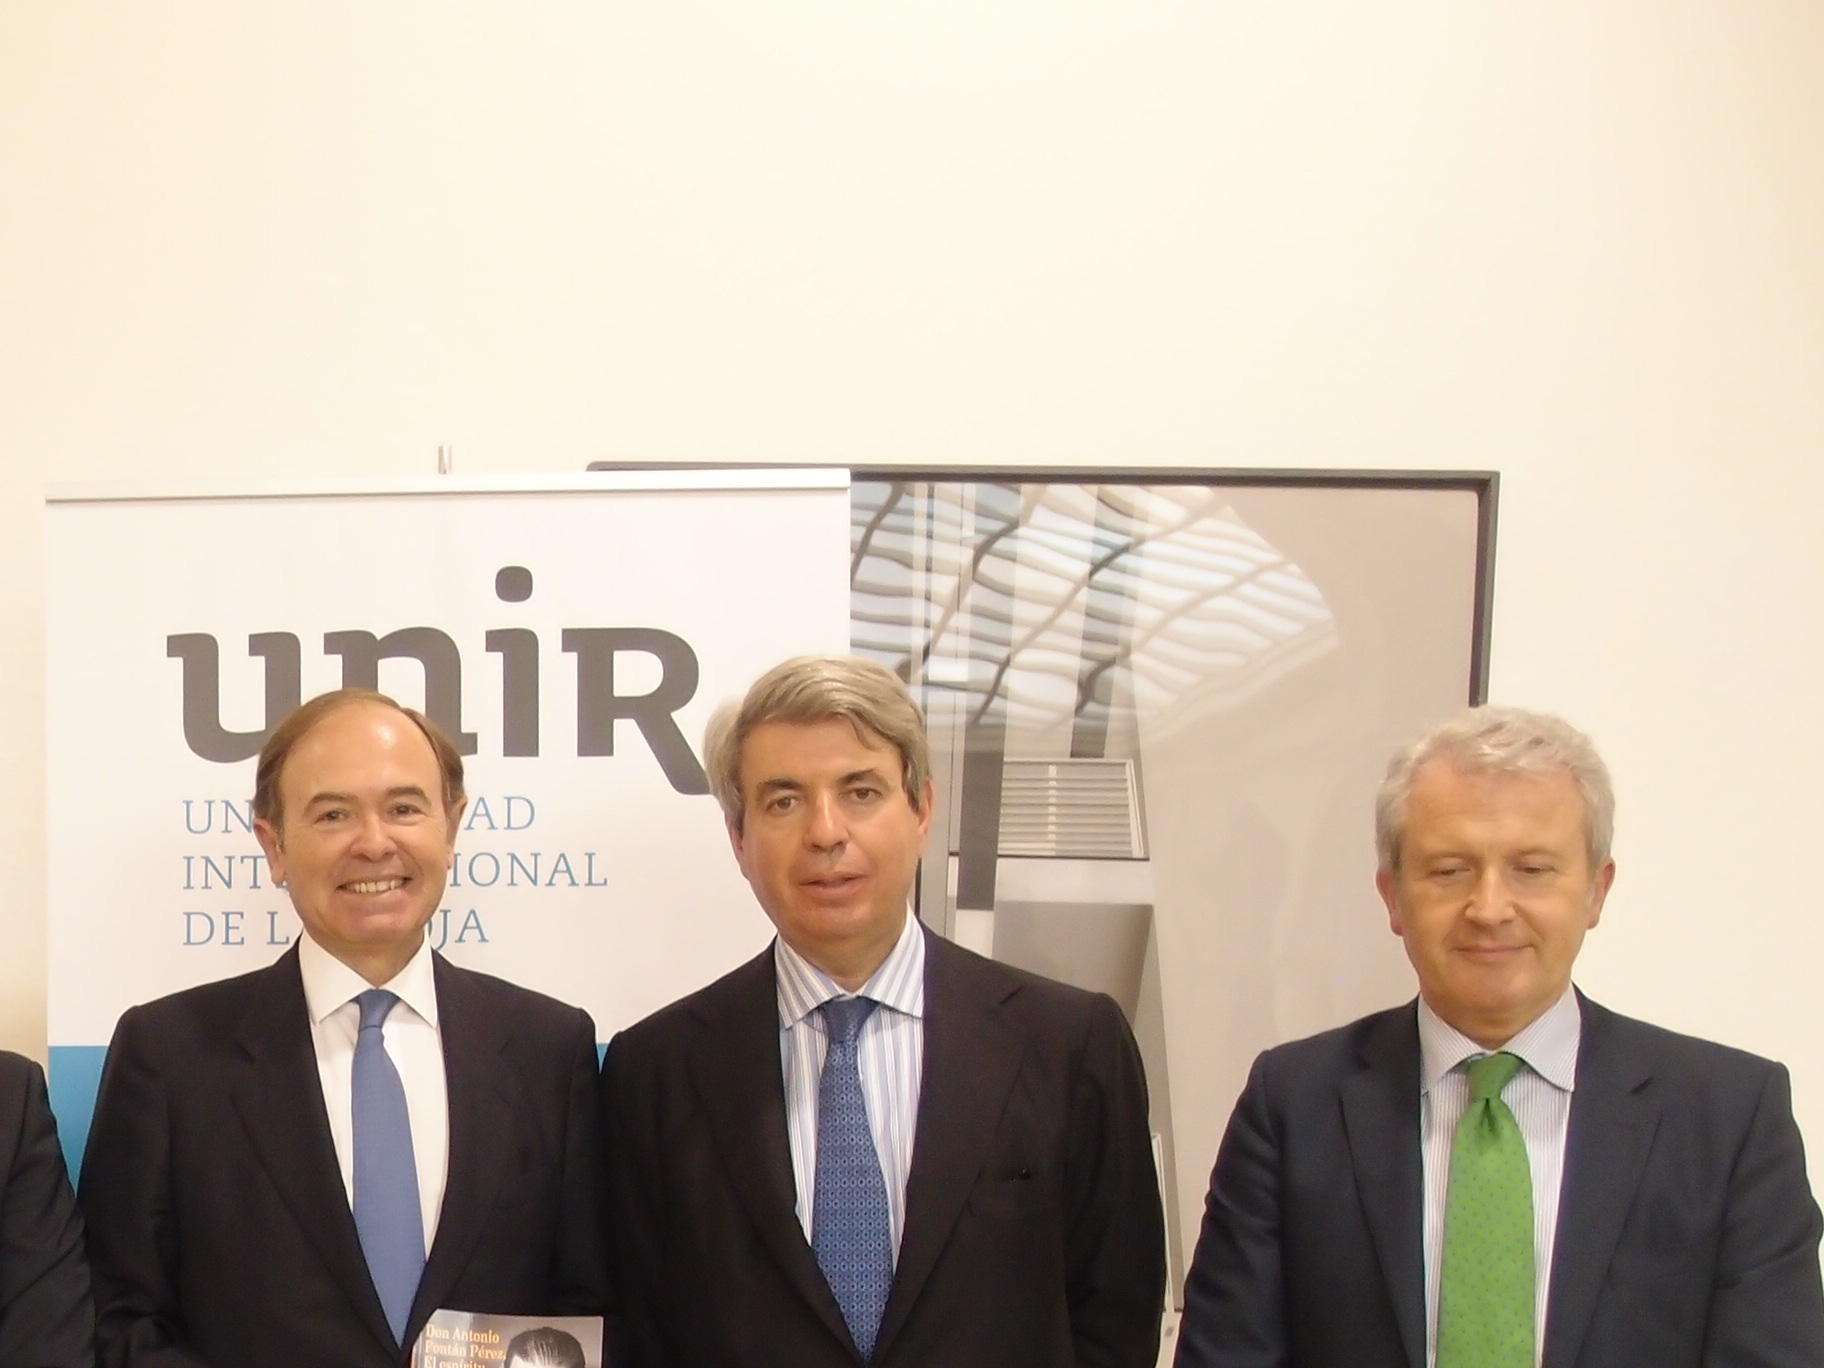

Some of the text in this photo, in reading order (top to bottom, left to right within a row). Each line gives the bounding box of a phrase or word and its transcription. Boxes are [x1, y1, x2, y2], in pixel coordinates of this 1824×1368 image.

[182, 851, 608, 890] INTIONAL
[182, 911, 245, 946] DE
[426, 1323, 500, 1344] Don Antonio
[424, 1339, 467, 1357] Fontán
